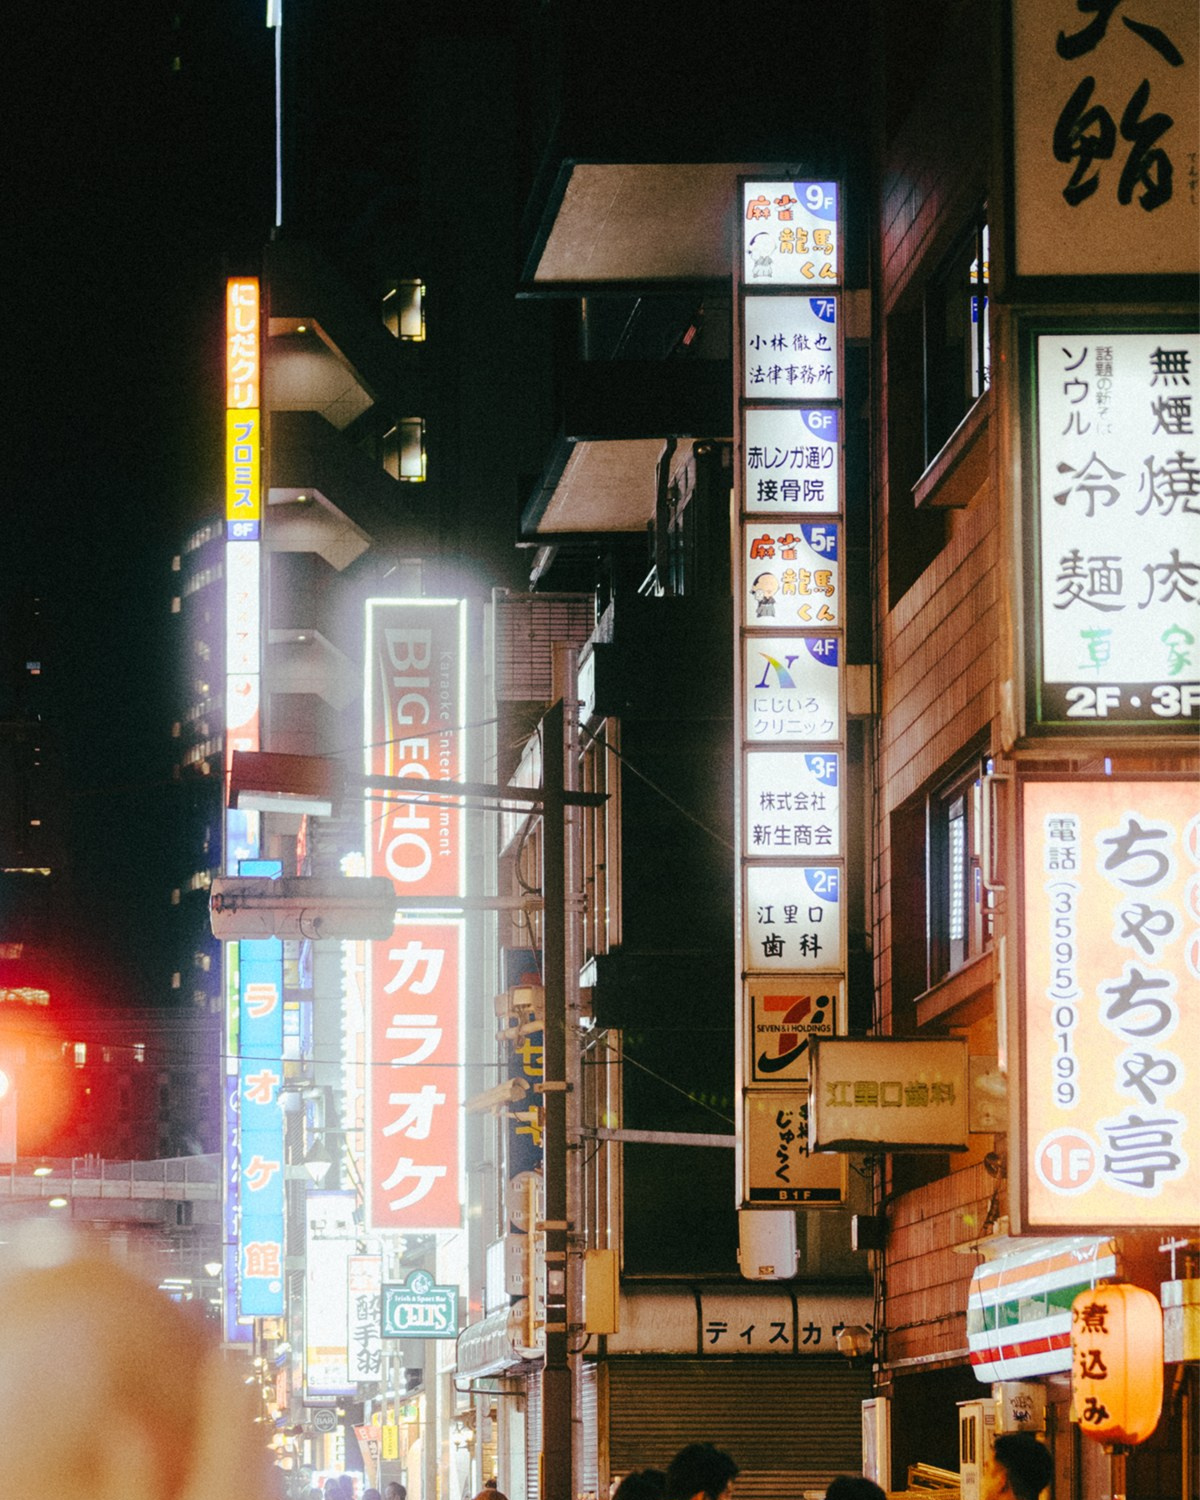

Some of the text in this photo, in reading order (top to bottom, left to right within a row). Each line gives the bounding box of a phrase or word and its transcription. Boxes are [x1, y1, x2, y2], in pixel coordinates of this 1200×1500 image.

[745, 194, 798, 222] 麻雀
[805, 185, 834, 212] 9F
[778, 227, 835, 255] 龍馬
[800, 260, 838, 281] くん
[816, 299, 835, 320] 7F
[231, 284, 256, 408] にしだクリ
[749, 333, 832, 353] 小林徹也
[749, 364, 834, 386] 法律事務所
[807, 411, 832, 430] 6F
[233, 420, 254, 508] プロミス
[748, 446, 835, 470] 赤レンガ通り
[757, 479, 825, 502] 接骨院
[749, 533, 802, 561] 麻雀
[810, 528, 836, 552] 5F
[780, 568, 835, 596] 龍馬
[797, 604, 836, 623] くん
[812, 639, 835, 655] 4F
[438, 650, 455, 721] Karaoke
[753, 696, 820, 714] にじいろ
[753, 718, 834, 736] クリニック
[385, 627, 432, 883] BIG ECHO
[810, 756, 836, 779] 3F
[759, 790, 827, 812] 株式会社
[752, 823, 834, 848] 新生商会
[812, 870, 838, 893] 2F
[756, 904, 824, 925] 江里口
[761, 932, 823, 959] 歯科
[1103, 818, 1181, 1189] ちゃちゃ亭
[791, 1023, 831, 1033] HOLDINGS
[381, 940, 447, 1212] カラオケ
[825, 1080, 956, 1108] 江里口歯科
[244, 983, 282, 1277] ラオケ館
[775, 1110, 795, 1183] じゅらく
[1044, 1142, 1092, 1183] 1F
[778, 1190, 812, 1201] B1F
[394, 1303, 447, 1331] CELTS
[705, 1321, 873, 1346] ディスカ
[1080, 1302, 1110, 1425] 煮込み
